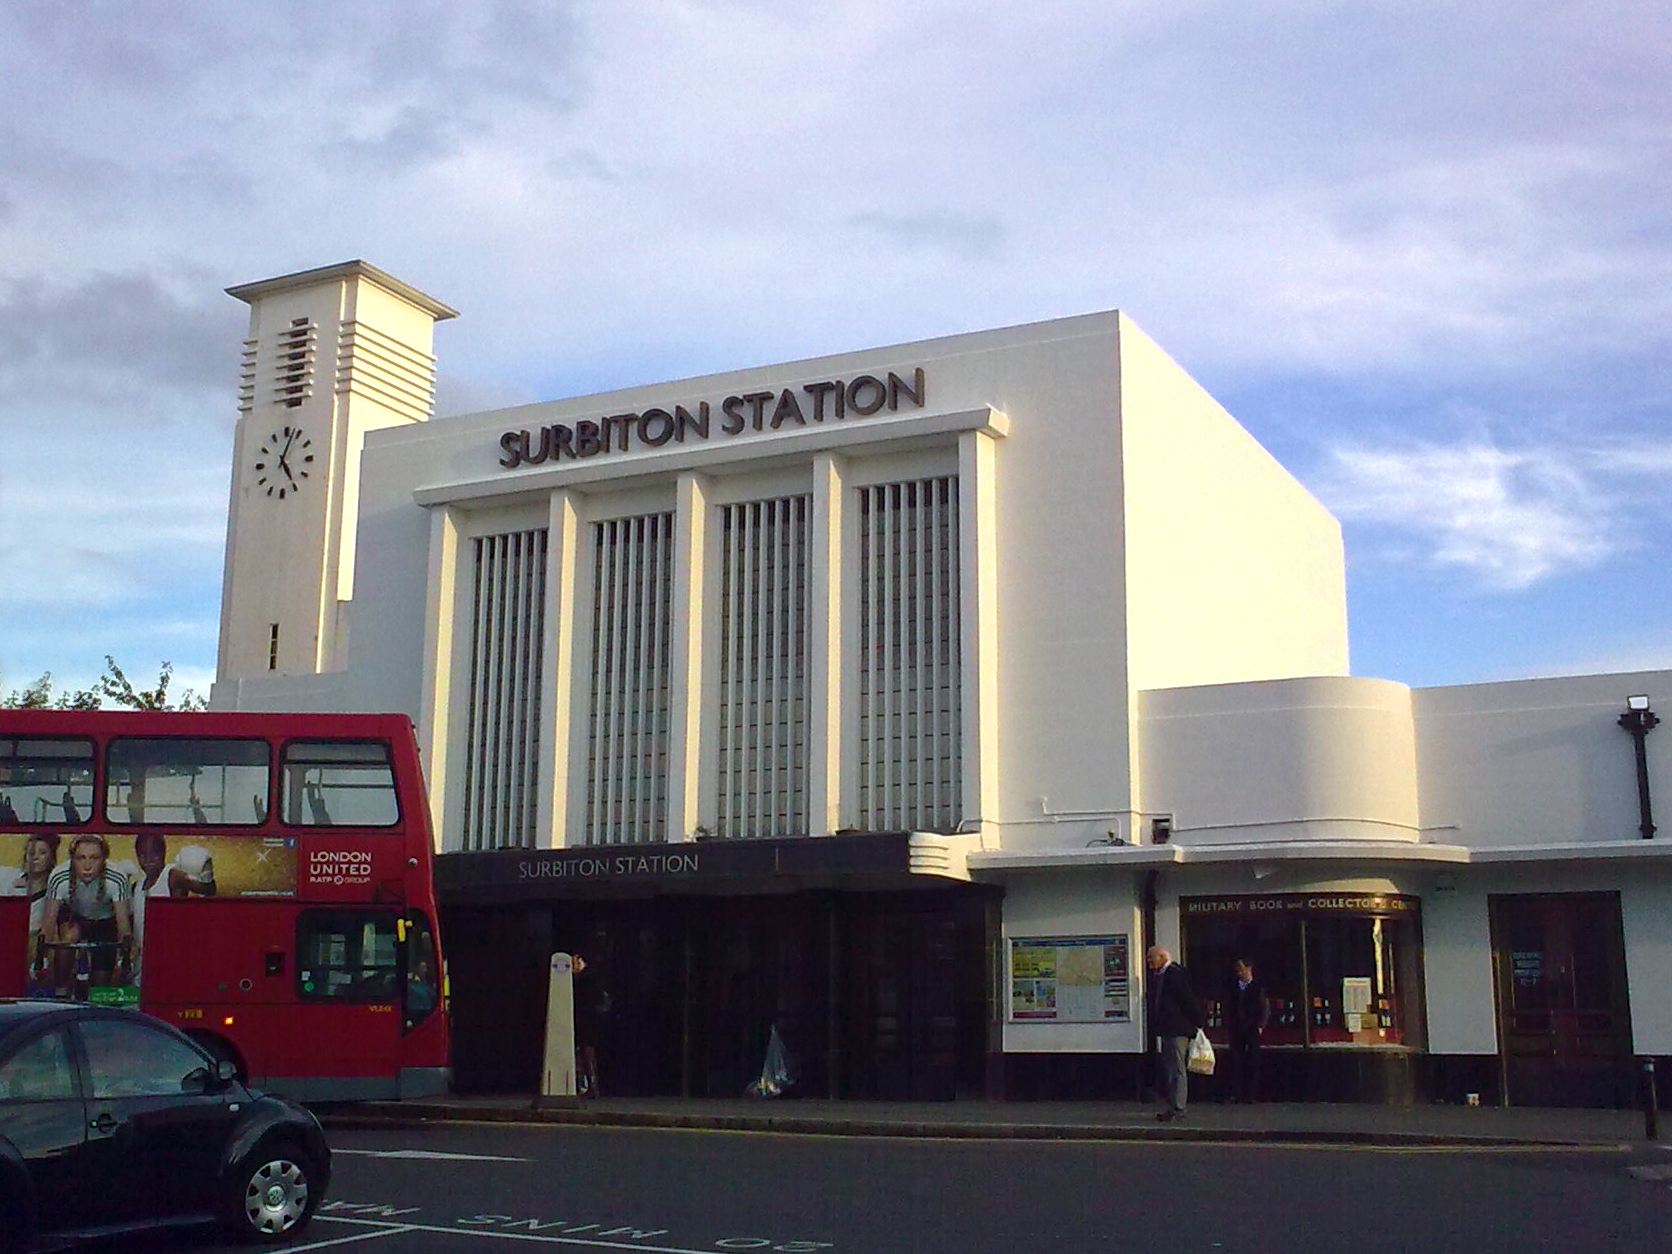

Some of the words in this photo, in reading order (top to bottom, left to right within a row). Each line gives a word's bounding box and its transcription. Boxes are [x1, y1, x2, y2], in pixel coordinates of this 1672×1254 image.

[499, 401, 709, 468] SURBITON
[721, 367, 925, 435] STATION
[309, 851, 371, 863] LONDON
[309, 863, 371, 875] UNITED
[518, 858, 610, 878] SURBITON
[615, 854, 699, 874] STATION
[344, 876, 371, 884] GROUP
[1188, 901, 1241, 911] MILITARY
[1250, 900, 1283, 910] BOOK
[318, 1200, 421, 1217] MA
[457, 1214, 669, 1239] MINS
